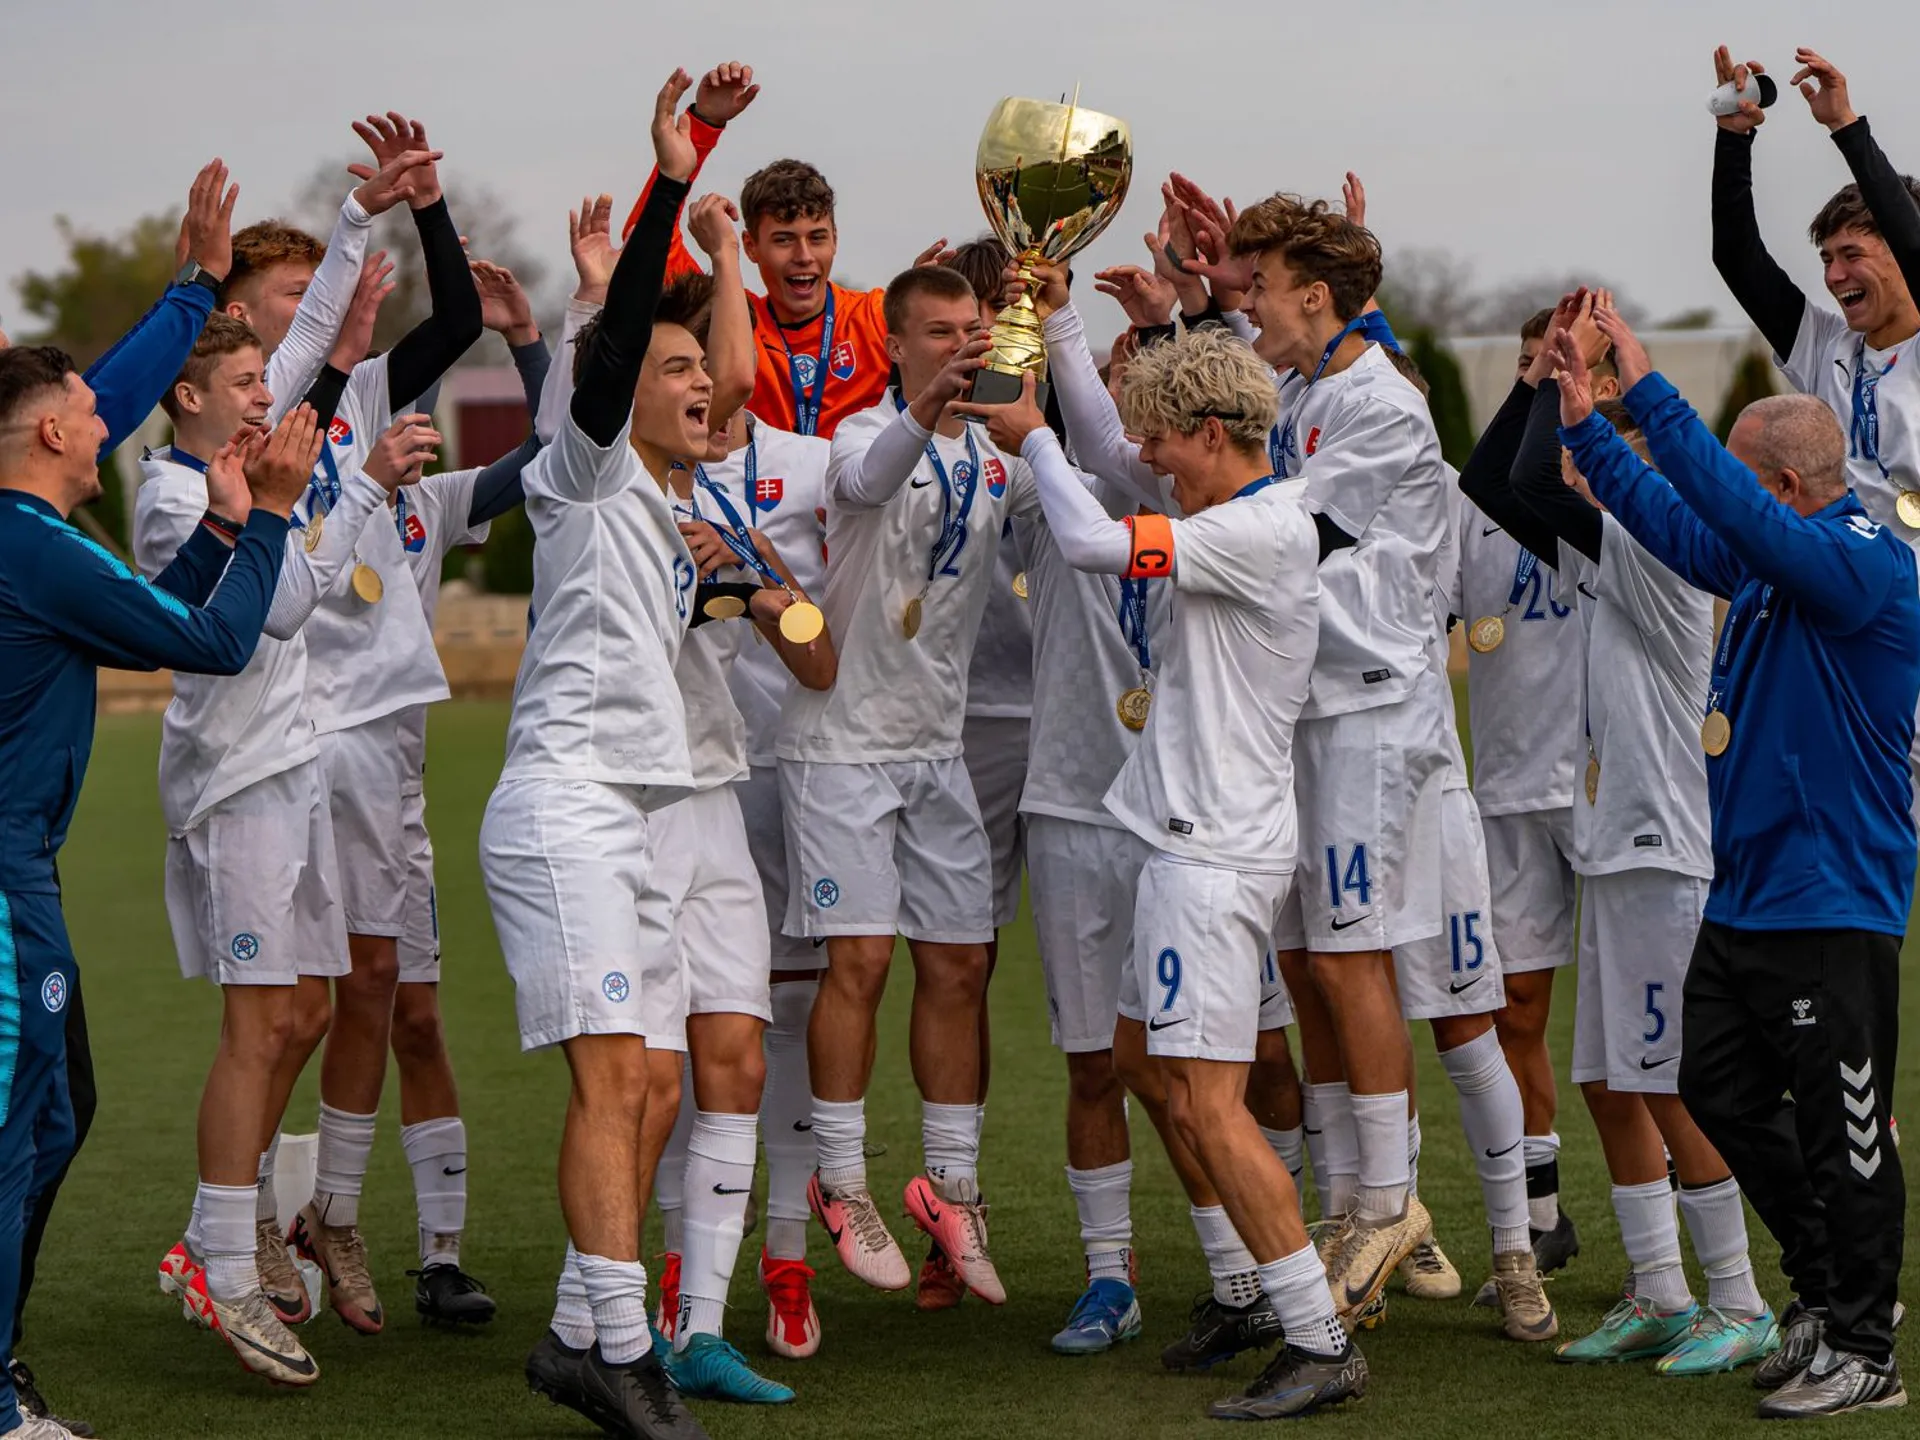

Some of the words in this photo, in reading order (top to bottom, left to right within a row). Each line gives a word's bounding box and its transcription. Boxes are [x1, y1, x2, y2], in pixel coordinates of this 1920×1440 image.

[1136, 549, 1168, 569] C
[1326, 843, 1372, 908] 14
[1450, 910, 1484, 973] 15
[1156, 946, 1182, 1012] 9
[1643, 982, 1666, 1044] 5
